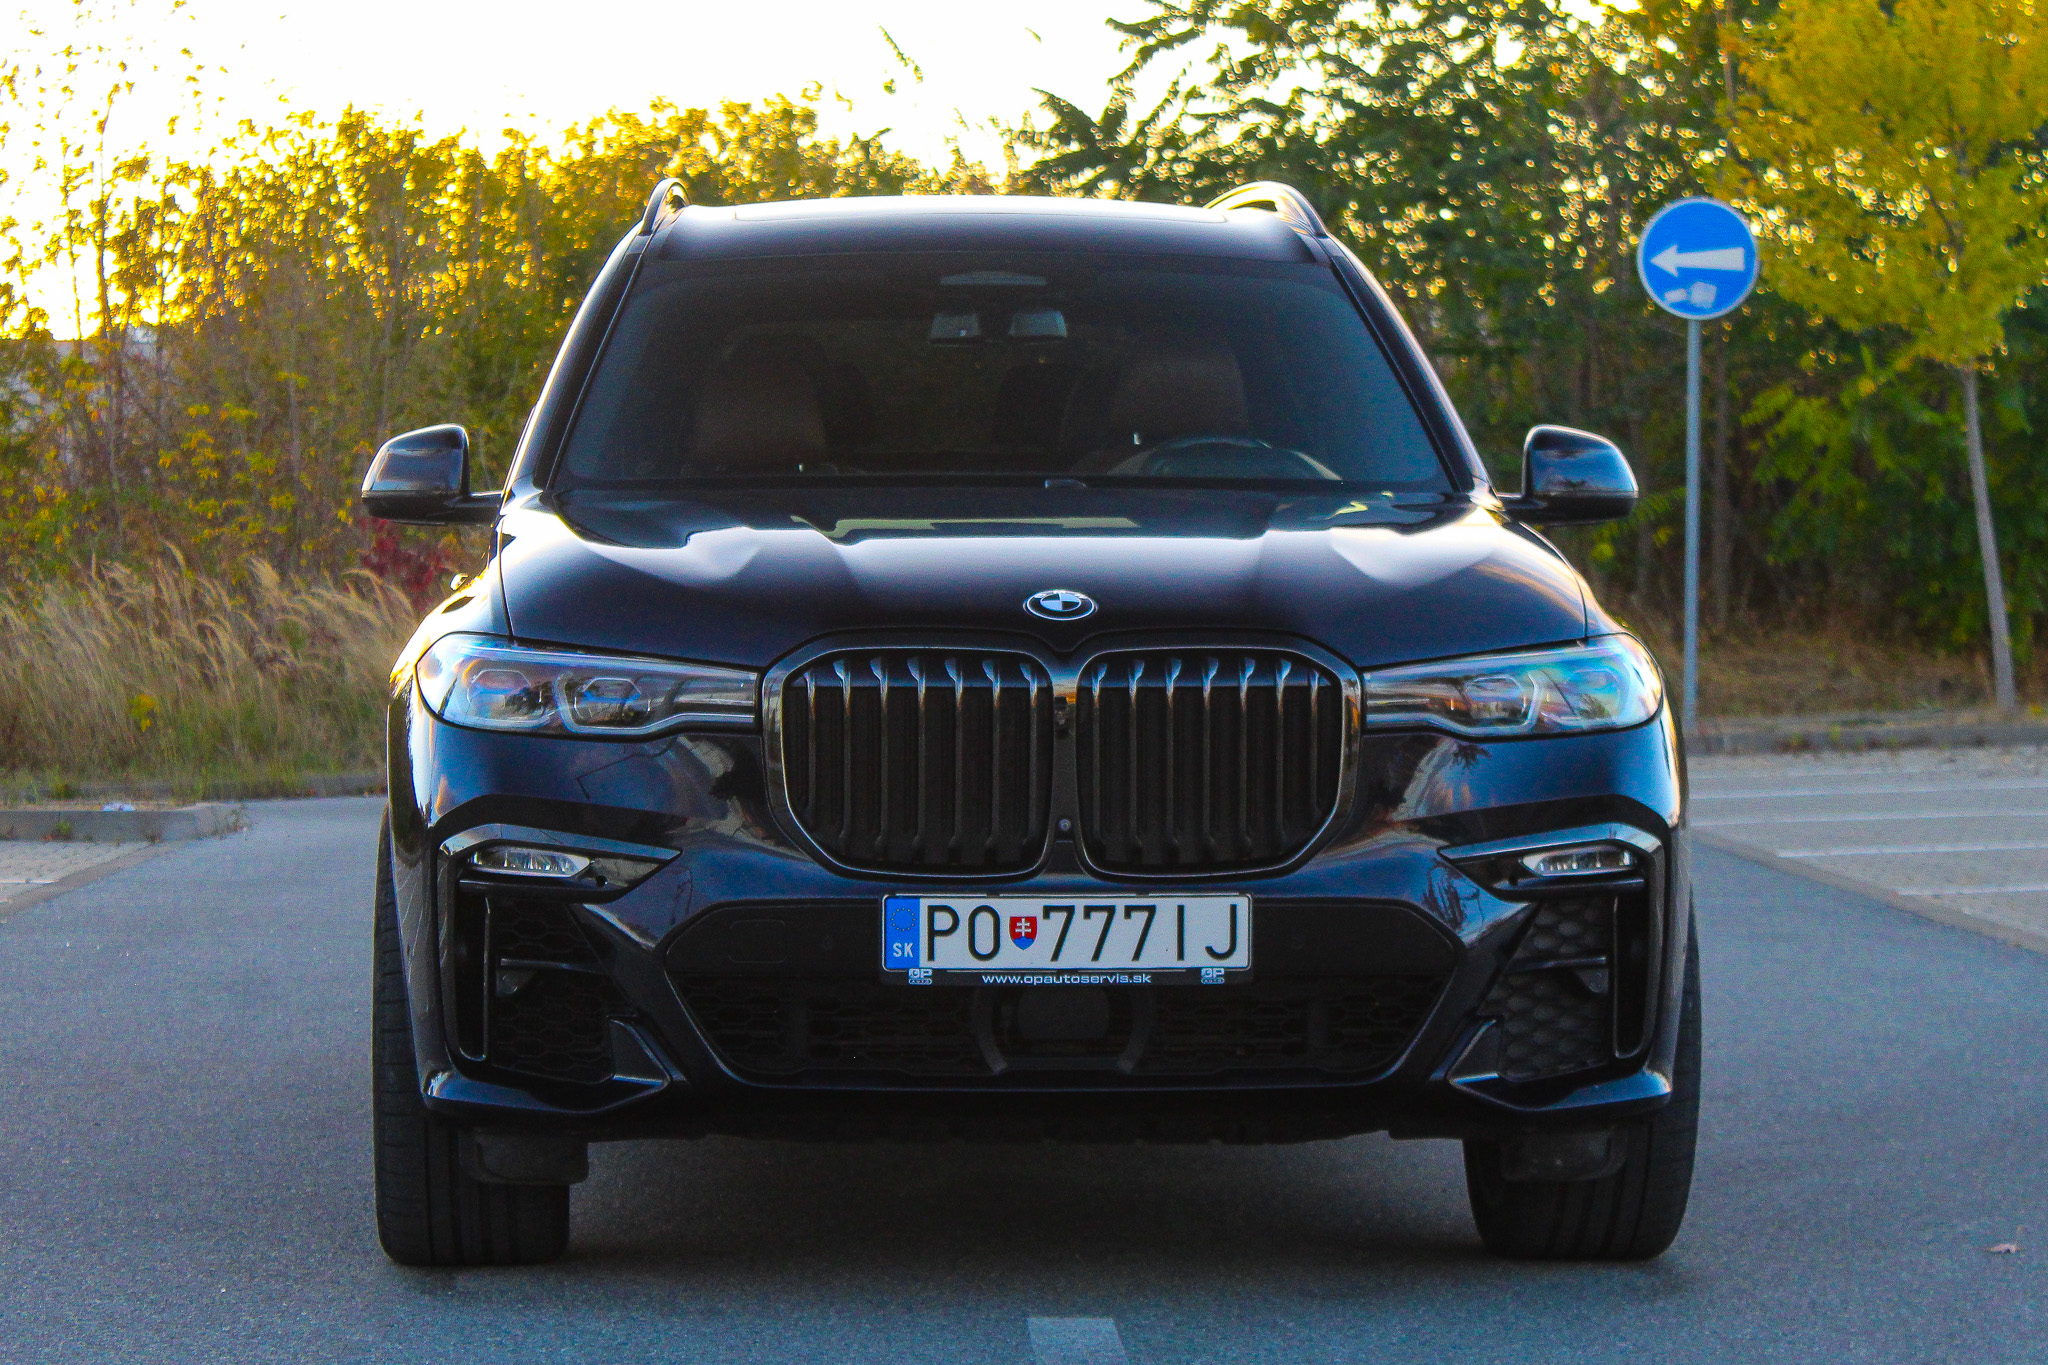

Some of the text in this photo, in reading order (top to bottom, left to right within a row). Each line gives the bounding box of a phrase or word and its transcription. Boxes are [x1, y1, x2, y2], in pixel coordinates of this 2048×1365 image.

[926, 904, 1001, 962] PO
[892, 942, 914, 958] SK
[981, 973, 1152, 986] www.opautoservis.sk
